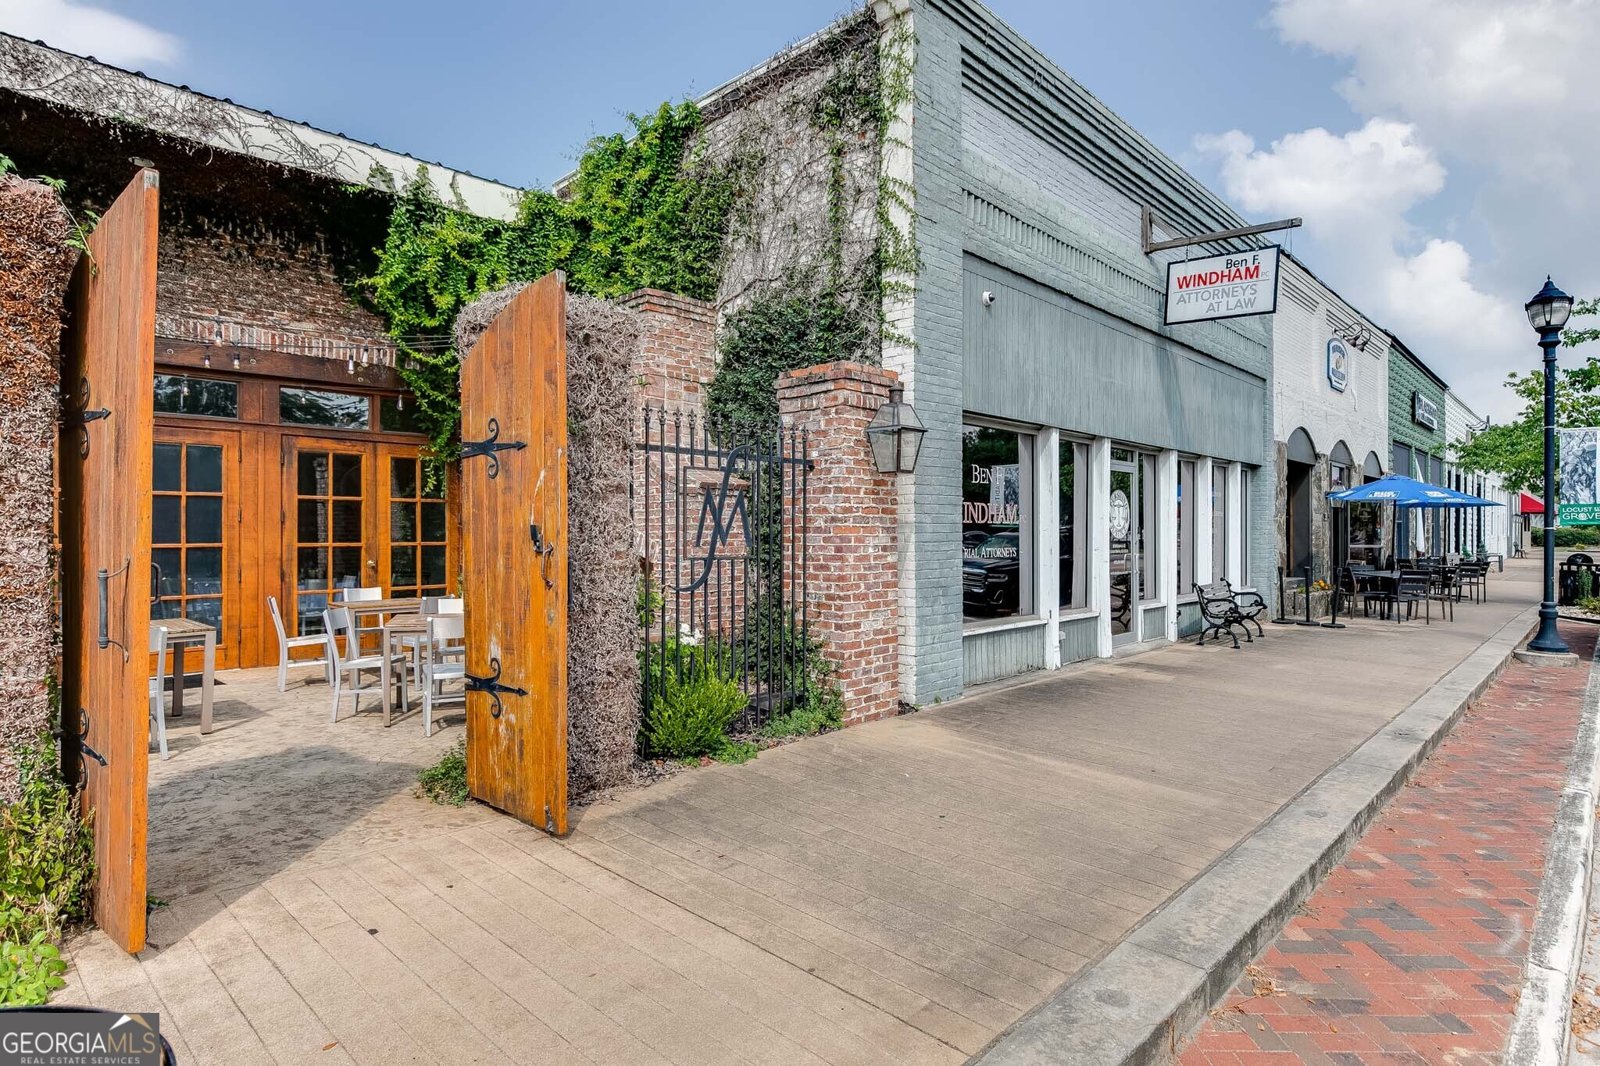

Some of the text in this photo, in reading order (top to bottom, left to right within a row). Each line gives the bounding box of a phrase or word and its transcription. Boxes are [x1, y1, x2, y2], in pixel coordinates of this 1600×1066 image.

[1226, 254, 1260, 269] Ben F.
[1177, 265, 1259, 289] WINDHAM
[1176, 284, 1258, 305] ATTORNEYS
[1206, 297, 1257, 313] AT LAW
[962, 501, 1019, 524] INDHAM
